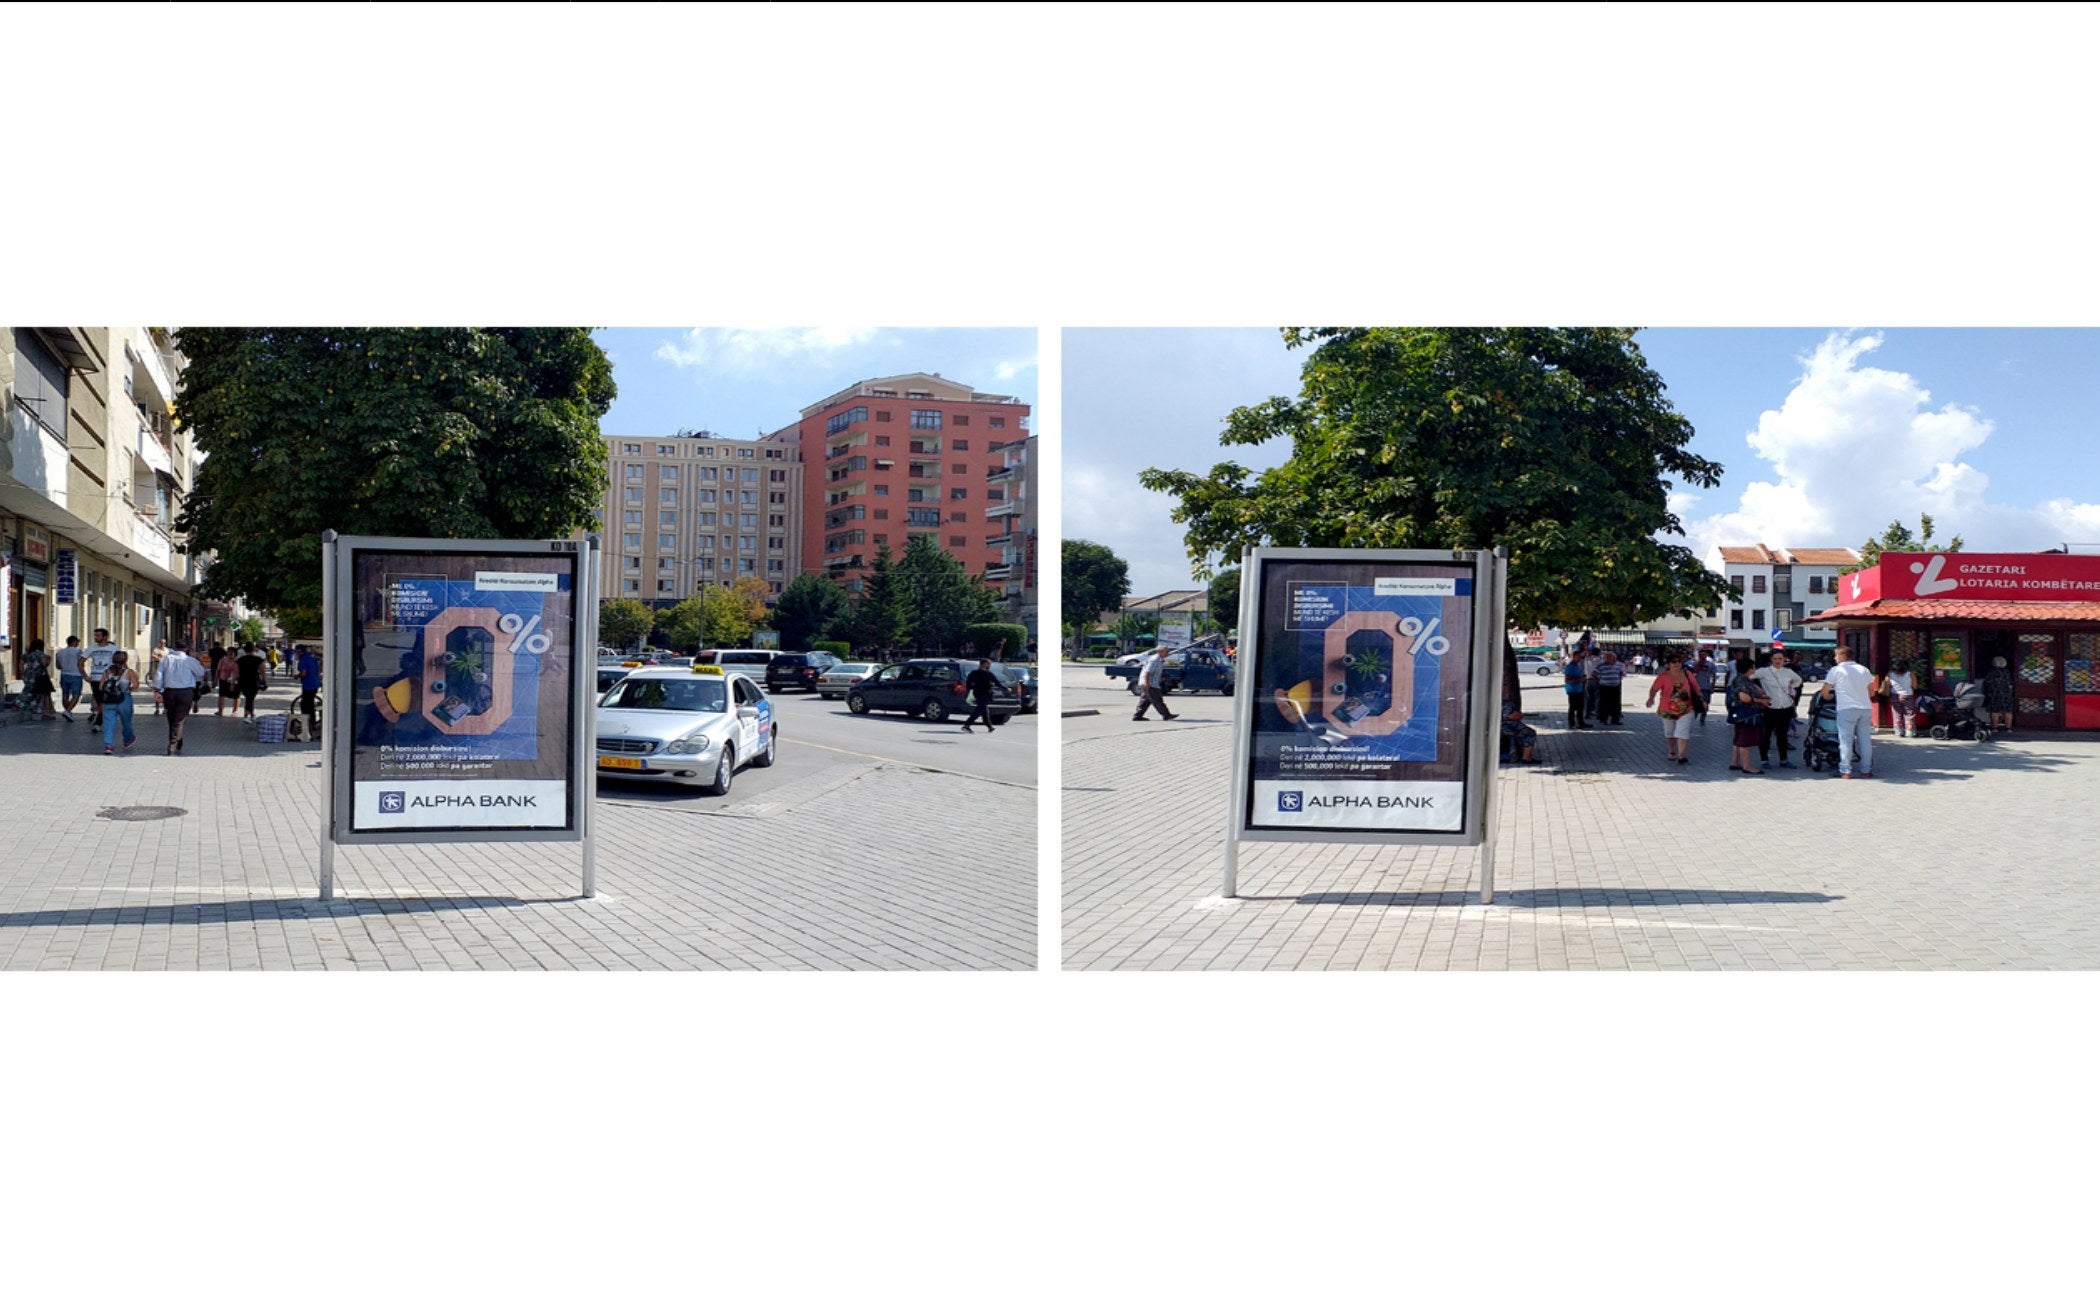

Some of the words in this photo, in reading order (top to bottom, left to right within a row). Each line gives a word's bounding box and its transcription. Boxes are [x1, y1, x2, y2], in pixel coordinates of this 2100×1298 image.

[1959, 564, 2026, 574] GAZETARI
[1960, 578, 2018, 588] LOTARIA
[2022, 578, 2100, 590] KOMBËTARE
[410, 795, 476, 807] ALPHA
[479, 795, 537, 807] BANK
[1307, 796, 1373, 808] ALPHA
[1377, 796, 1434, 808] BANK
